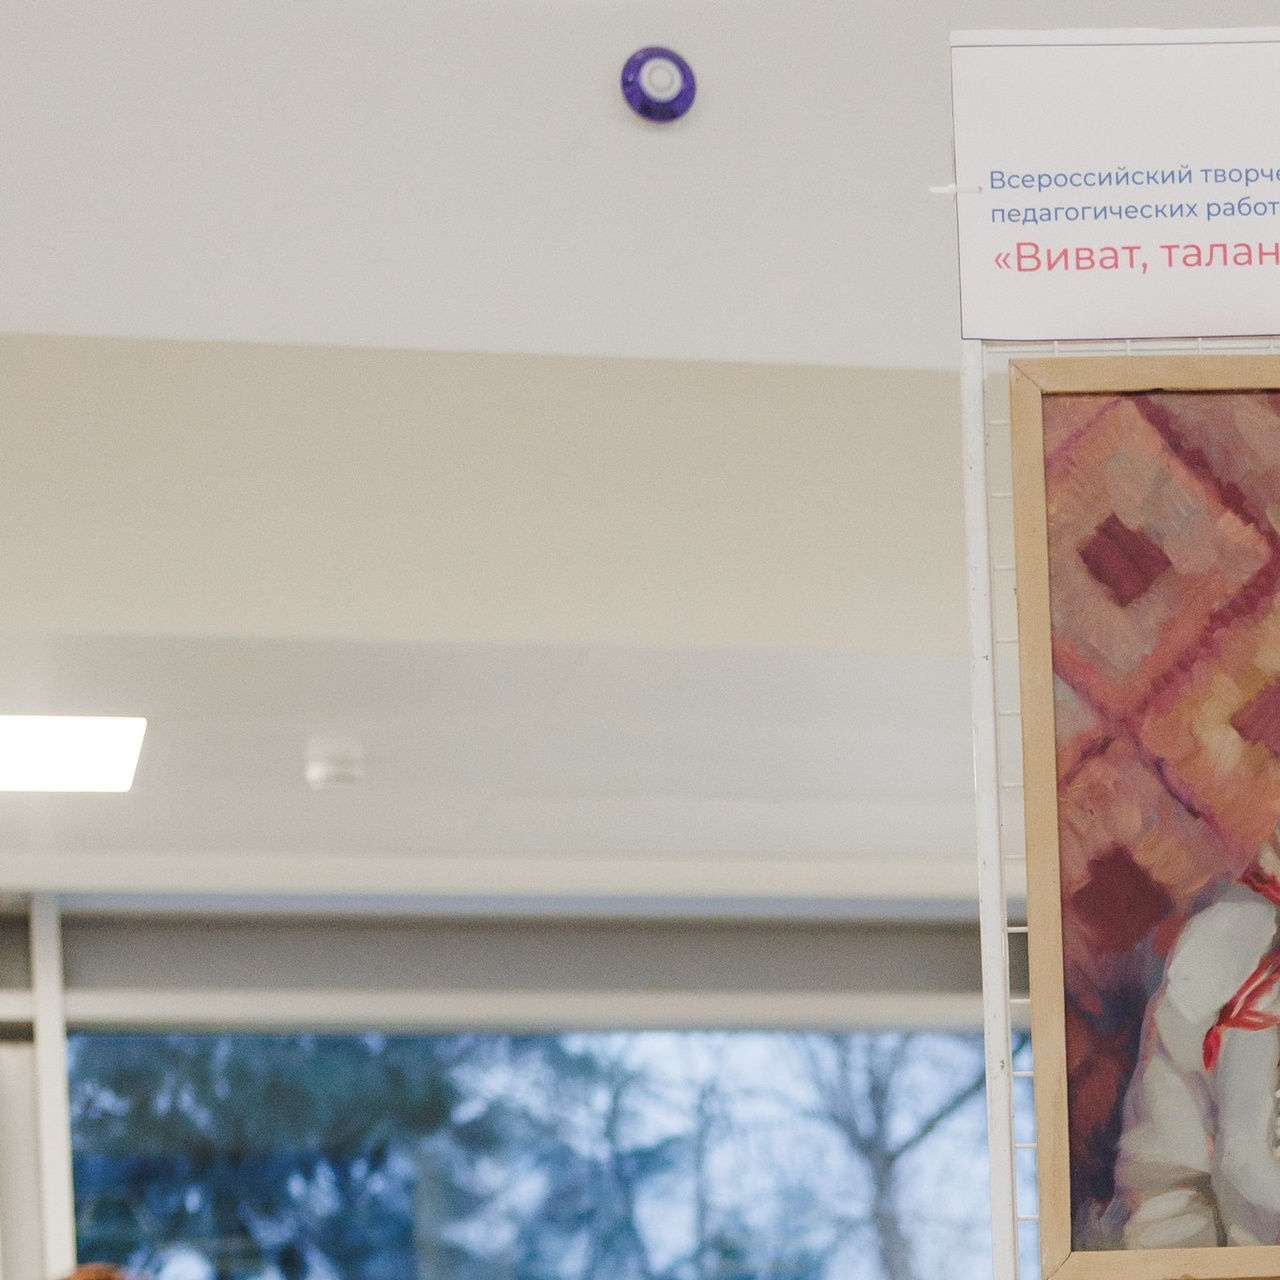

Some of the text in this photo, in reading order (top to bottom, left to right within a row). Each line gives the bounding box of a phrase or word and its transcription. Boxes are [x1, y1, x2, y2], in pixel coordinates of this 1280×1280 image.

[989, 164, 1193, 191] Всероссийский
[990, 200, 1198, 225] педагогических
[994, 240, 1149, 274] «Виват,
